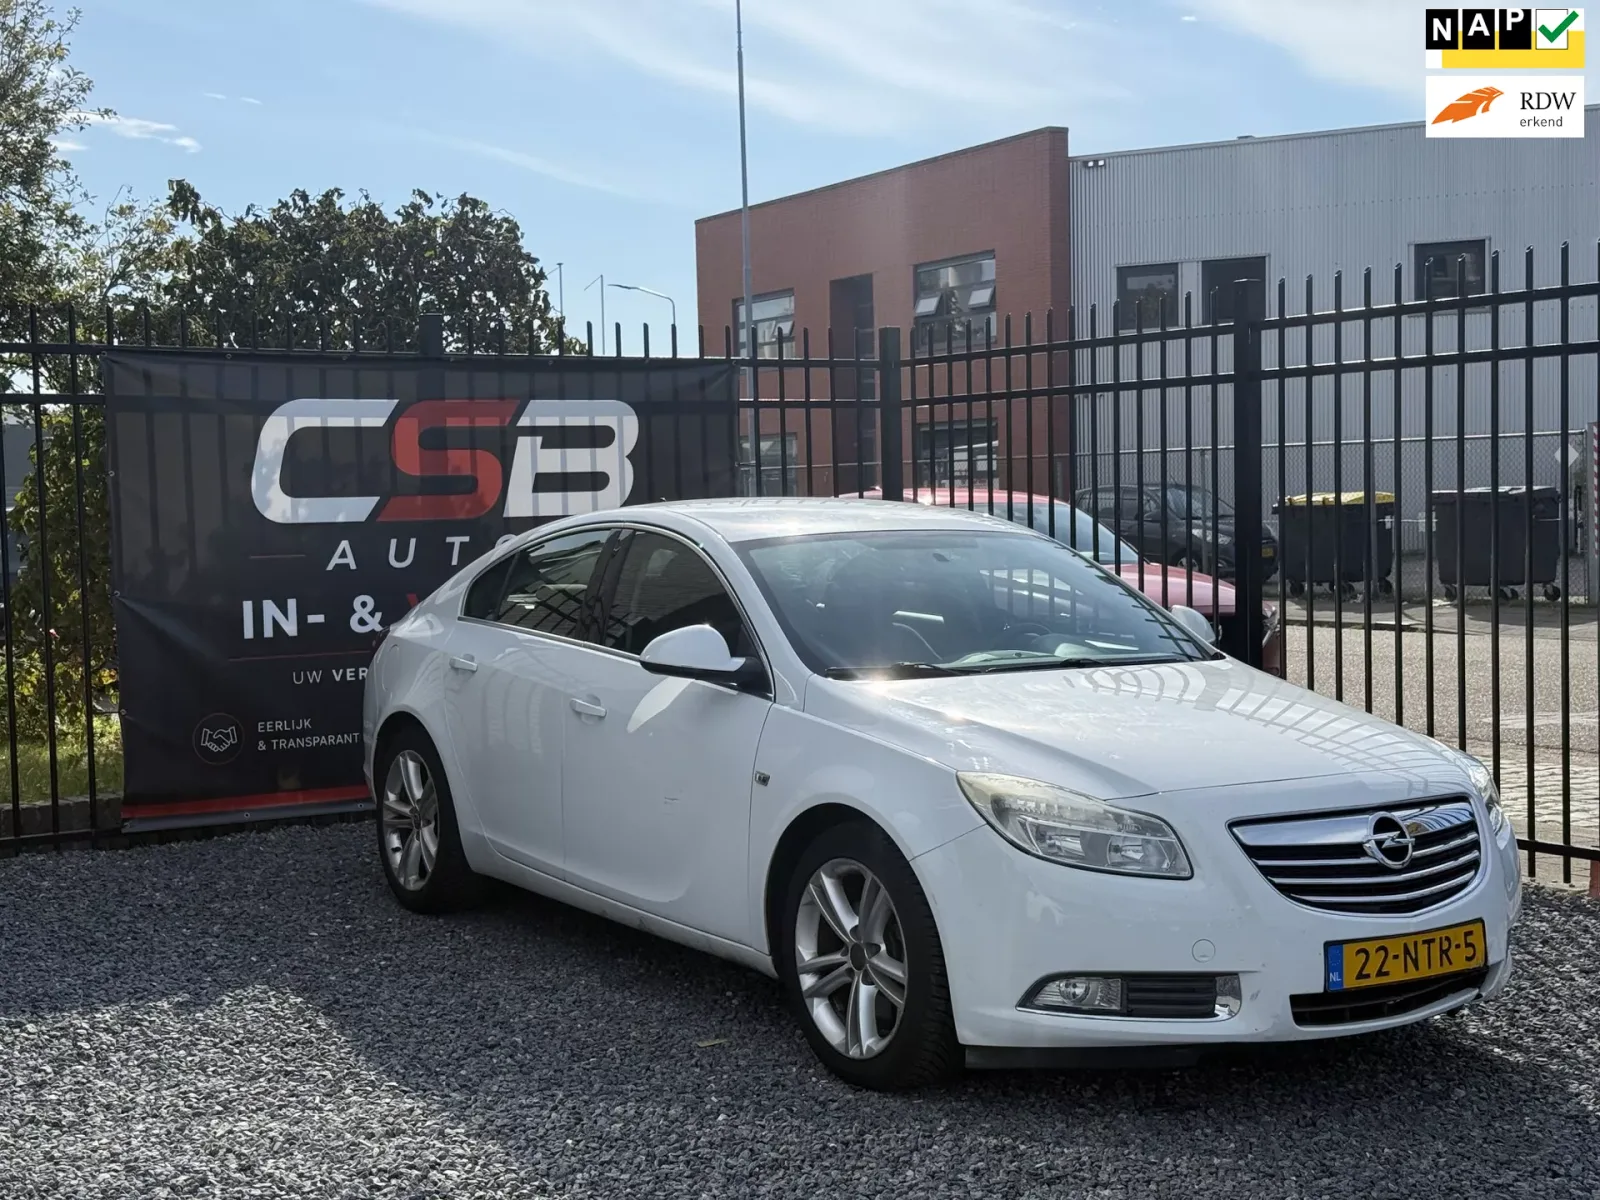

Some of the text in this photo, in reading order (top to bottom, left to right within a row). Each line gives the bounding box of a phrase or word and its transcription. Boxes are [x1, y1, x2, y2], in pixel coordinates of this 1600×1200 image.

[251, 398, 639, 524] CSB
[242, 594, 383, 640] IN- &
[292, 670, 323, 685] UW
[257, 718, 312, 733] EERLIJK
[257, 732, 360, 751] & TRANSPARANT
[1329, 930, 1477, 982] NL 22-NTR-5
